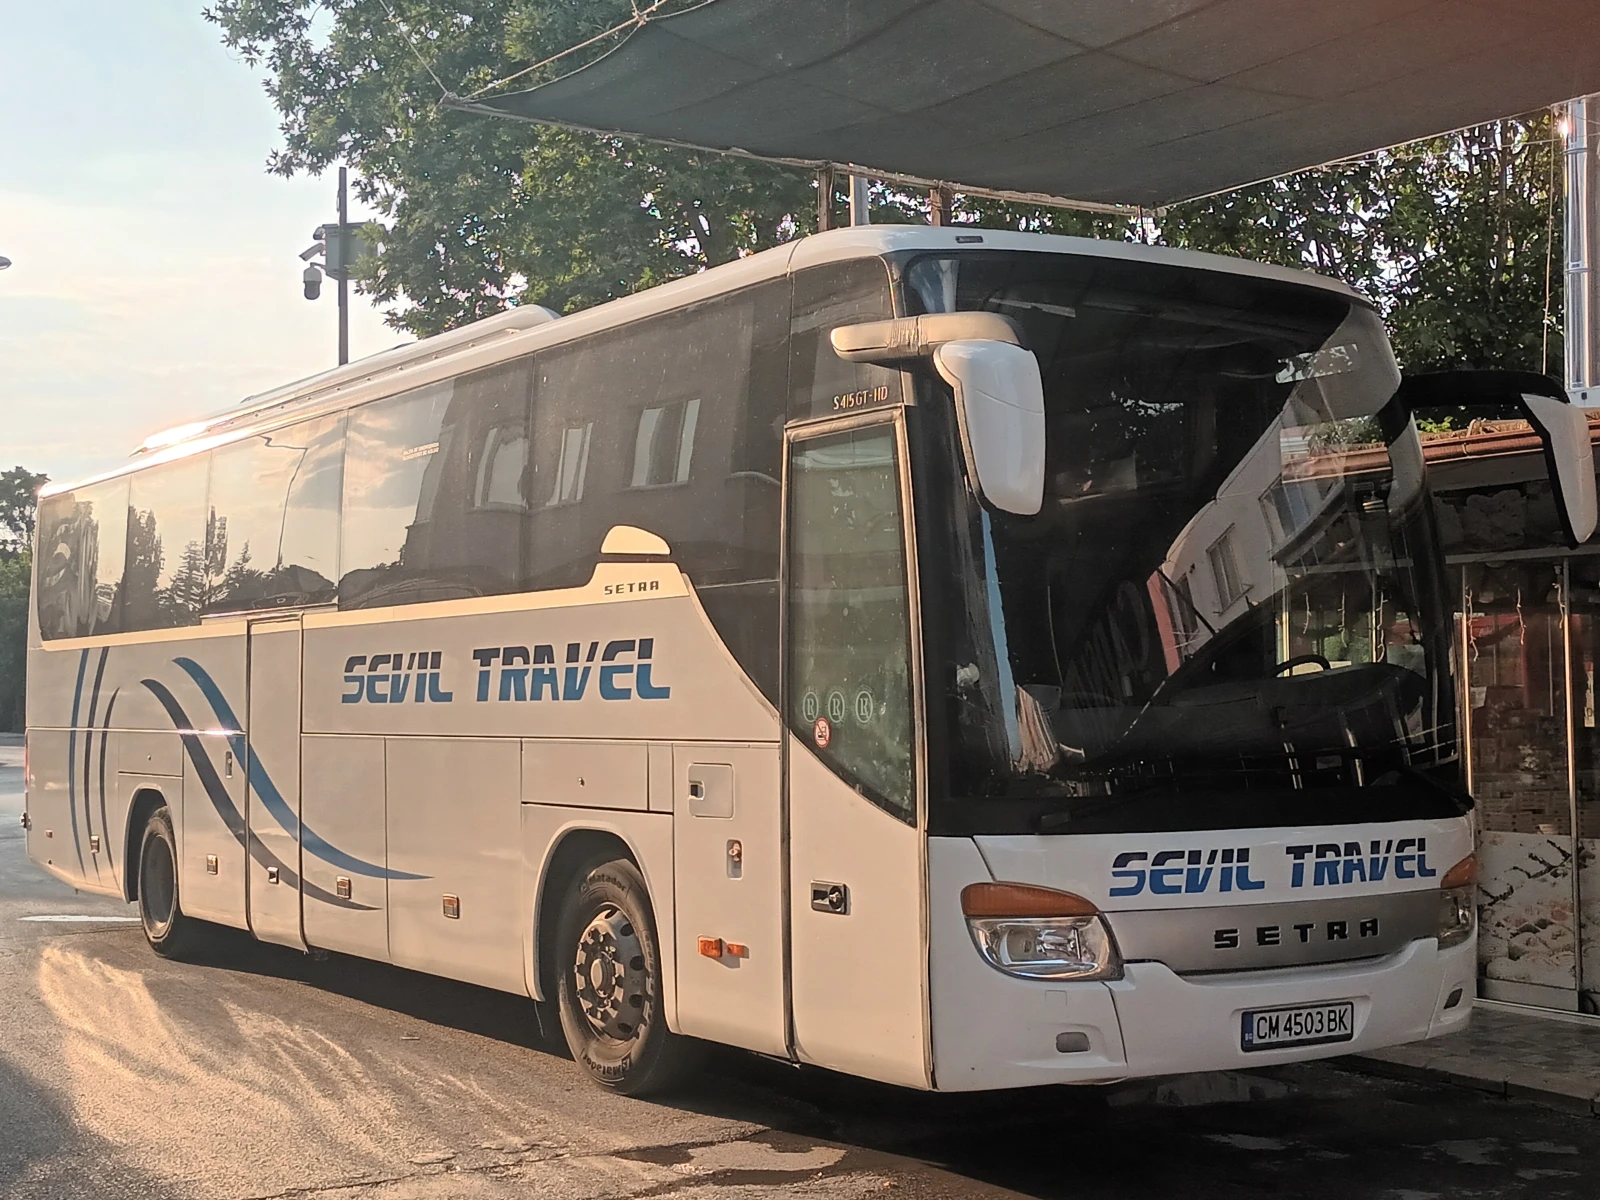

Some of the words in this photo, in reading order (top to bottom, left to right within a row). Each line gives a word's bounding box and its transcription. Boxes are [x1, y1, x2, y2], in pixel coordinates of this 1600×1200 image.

[604, 580, 659, 595] SETRA
[341, 651, 454, 704] SEVIL
[473, 637, 671, 702] TRAVEL
[1109, 847, 1266, 897] SEVIL
[1285, 837, 1437, 888] TRAVEL
[1214, 918, 1380, 949] SETRA
[1283, 1011, 1325, 1037] 4503
